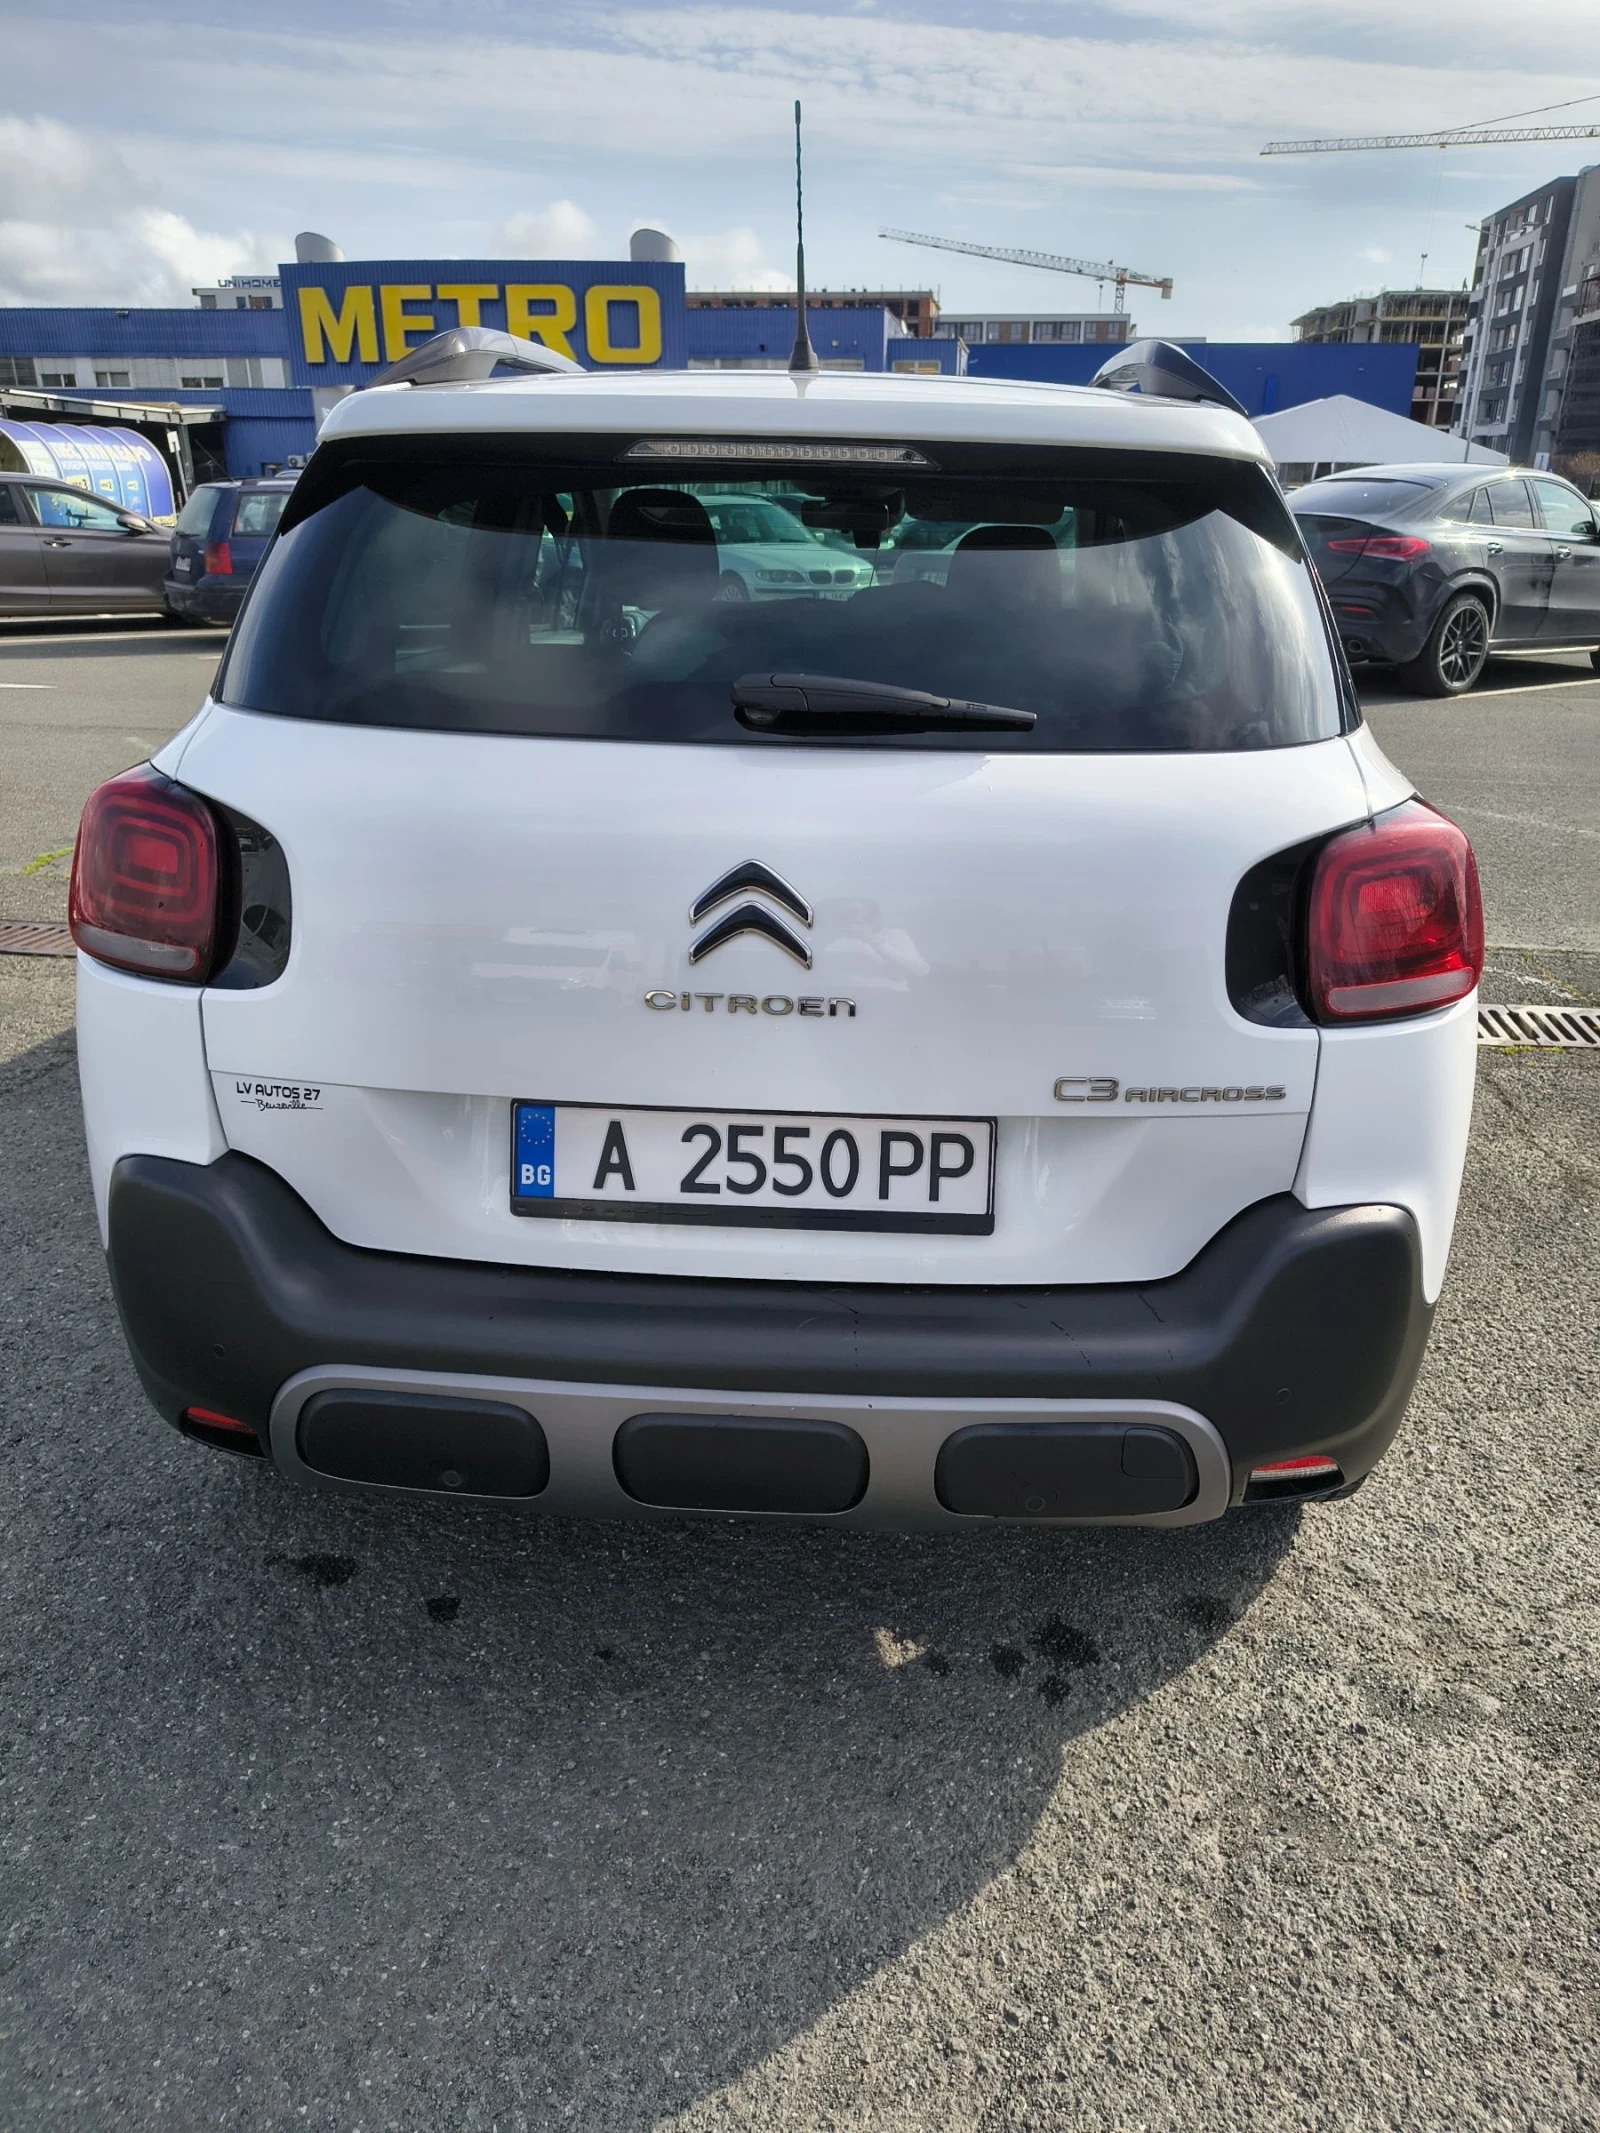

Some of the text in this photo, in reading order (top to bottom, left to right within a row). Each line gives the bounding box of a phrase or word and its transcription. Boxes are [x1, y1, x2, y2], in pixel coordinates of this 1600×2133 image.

[217, 279, 282, 288] UNIHOME
[298, 284, 663, 364] METRO
[236, 1081, 321, 1101] LV AUTOS 27
[1053, 1076, 1287, 1103] C3 AIRCROSS
[592, 1120, 975, 1202] A 2550 PP
[521, 1163, 552, 1185] BG
